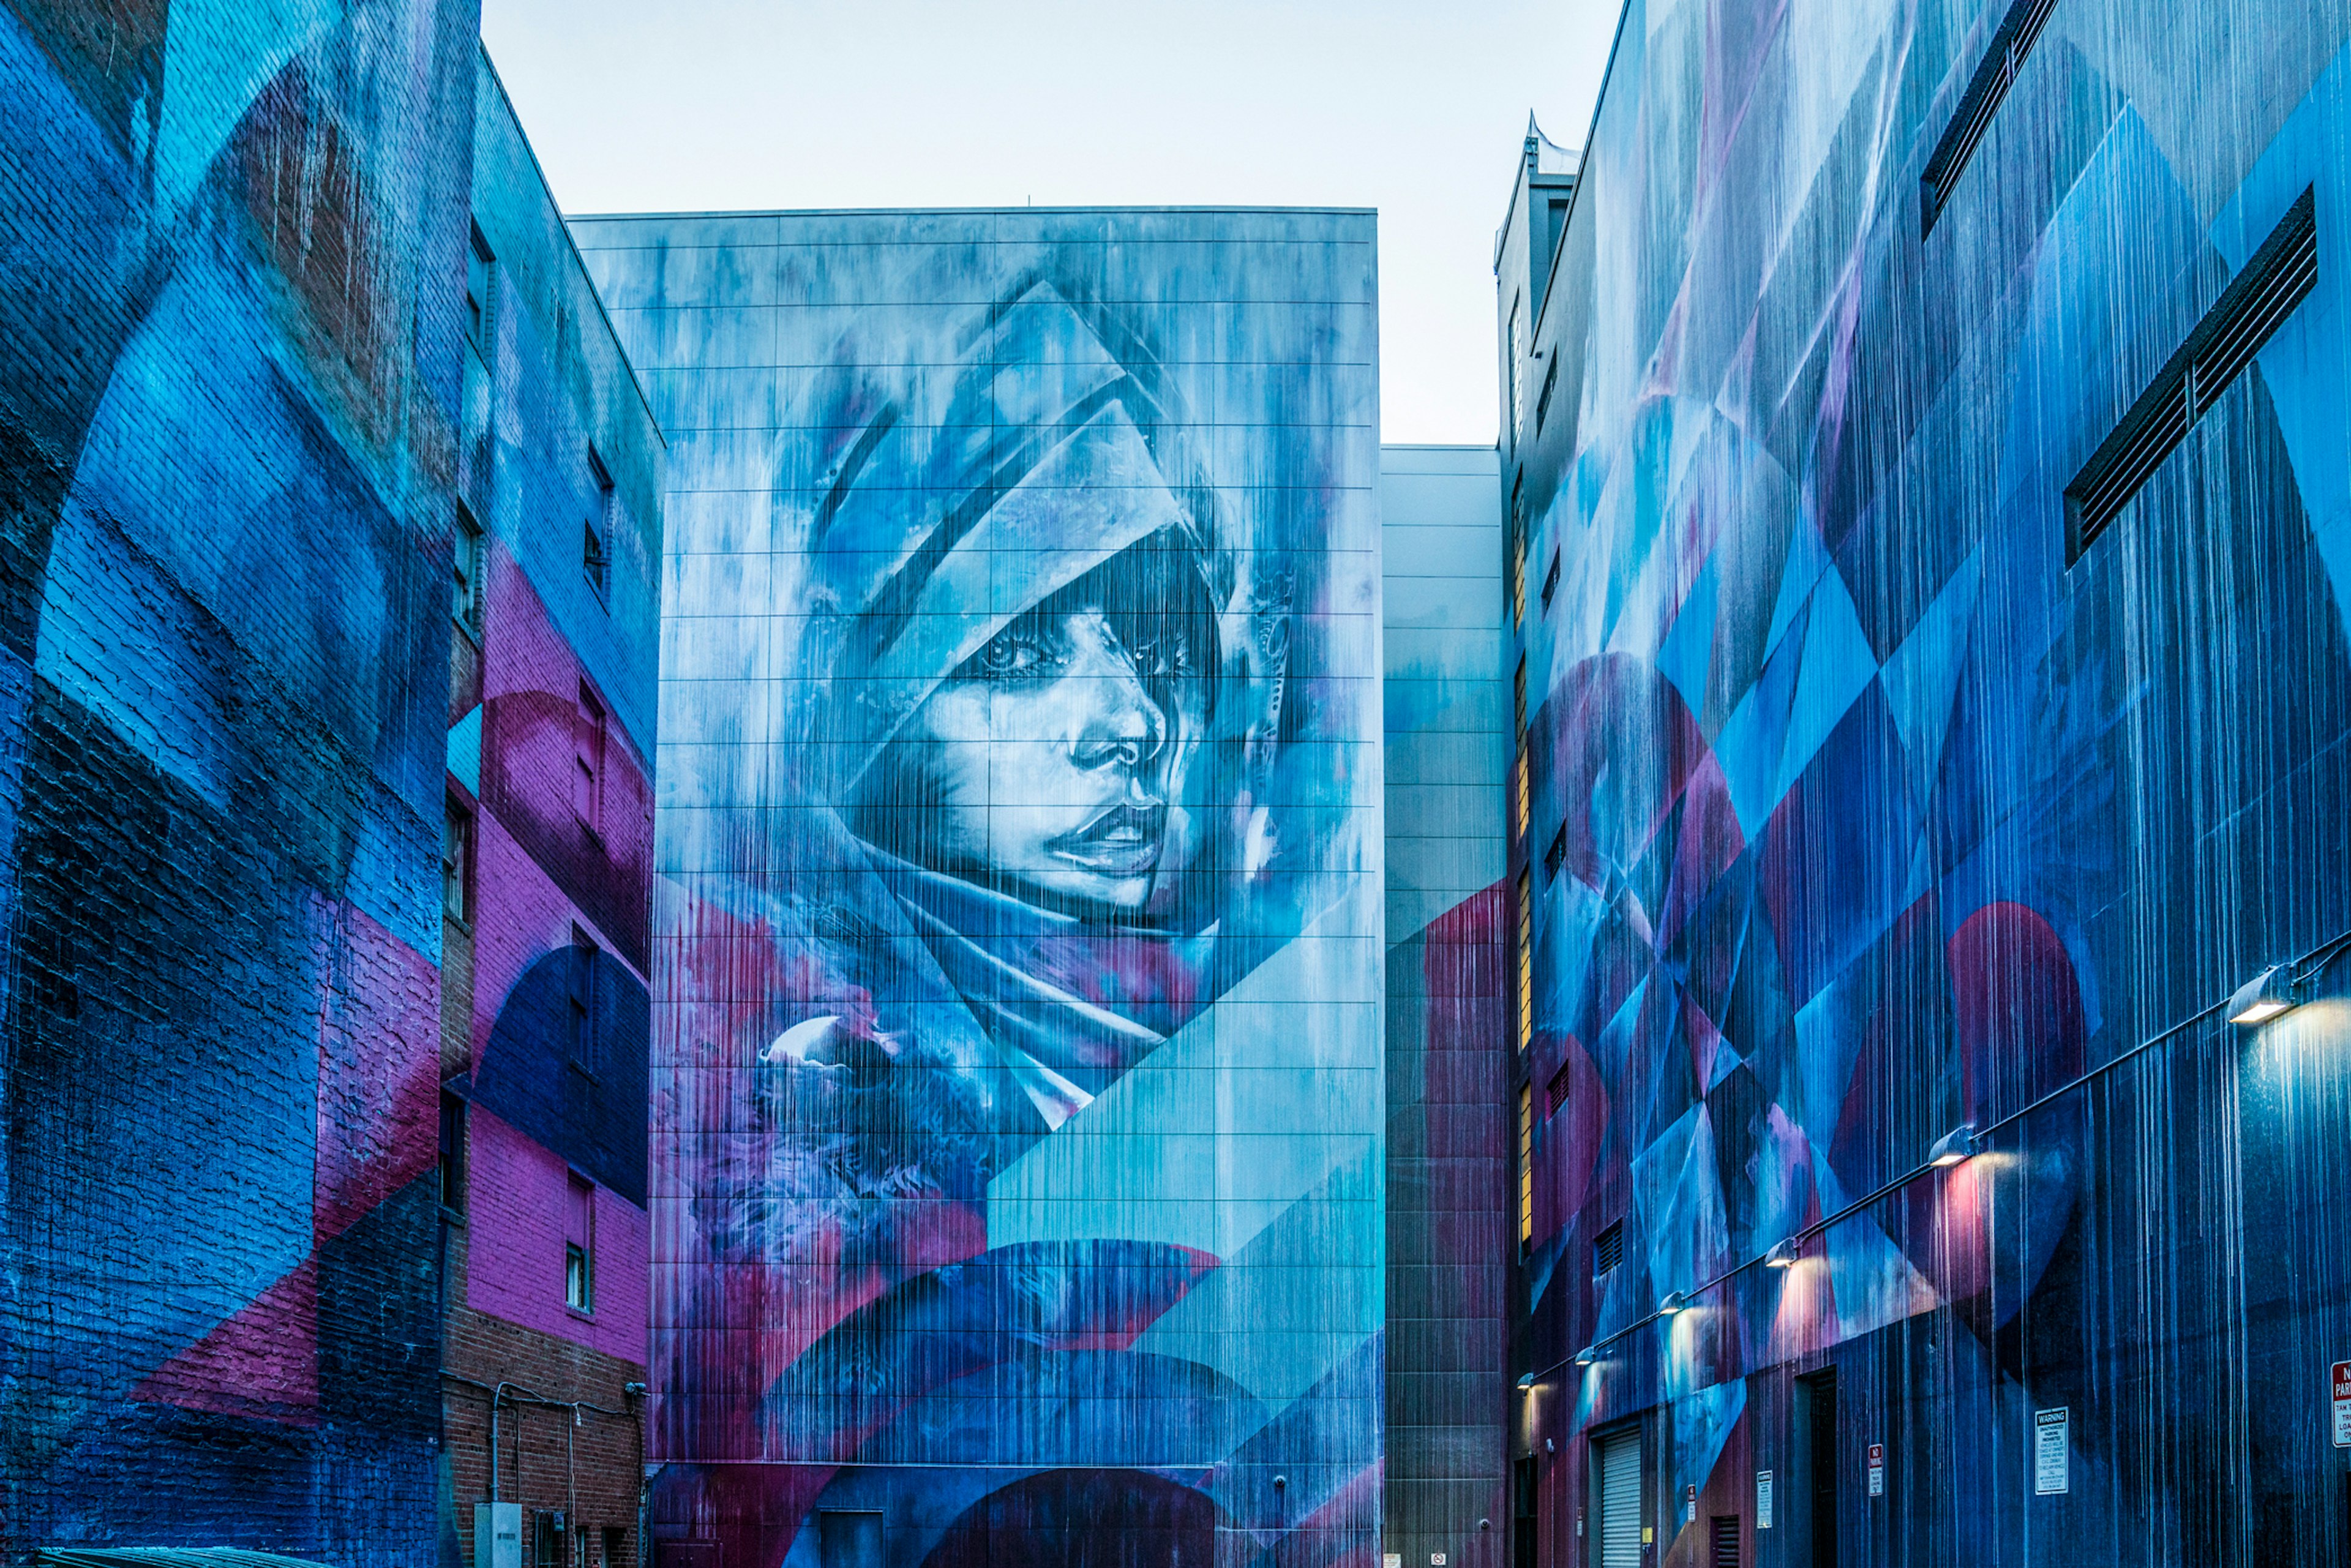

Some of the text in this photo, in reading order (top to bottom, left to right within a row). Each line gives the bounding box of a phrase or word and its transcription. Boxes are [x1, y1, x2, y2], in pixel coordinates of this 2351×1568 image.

[2344, 1367, 2351, 1381] N
[2336, 1382, 2351, 1396] PAR
[2038, 1412, 2064, 1424] WARNING
